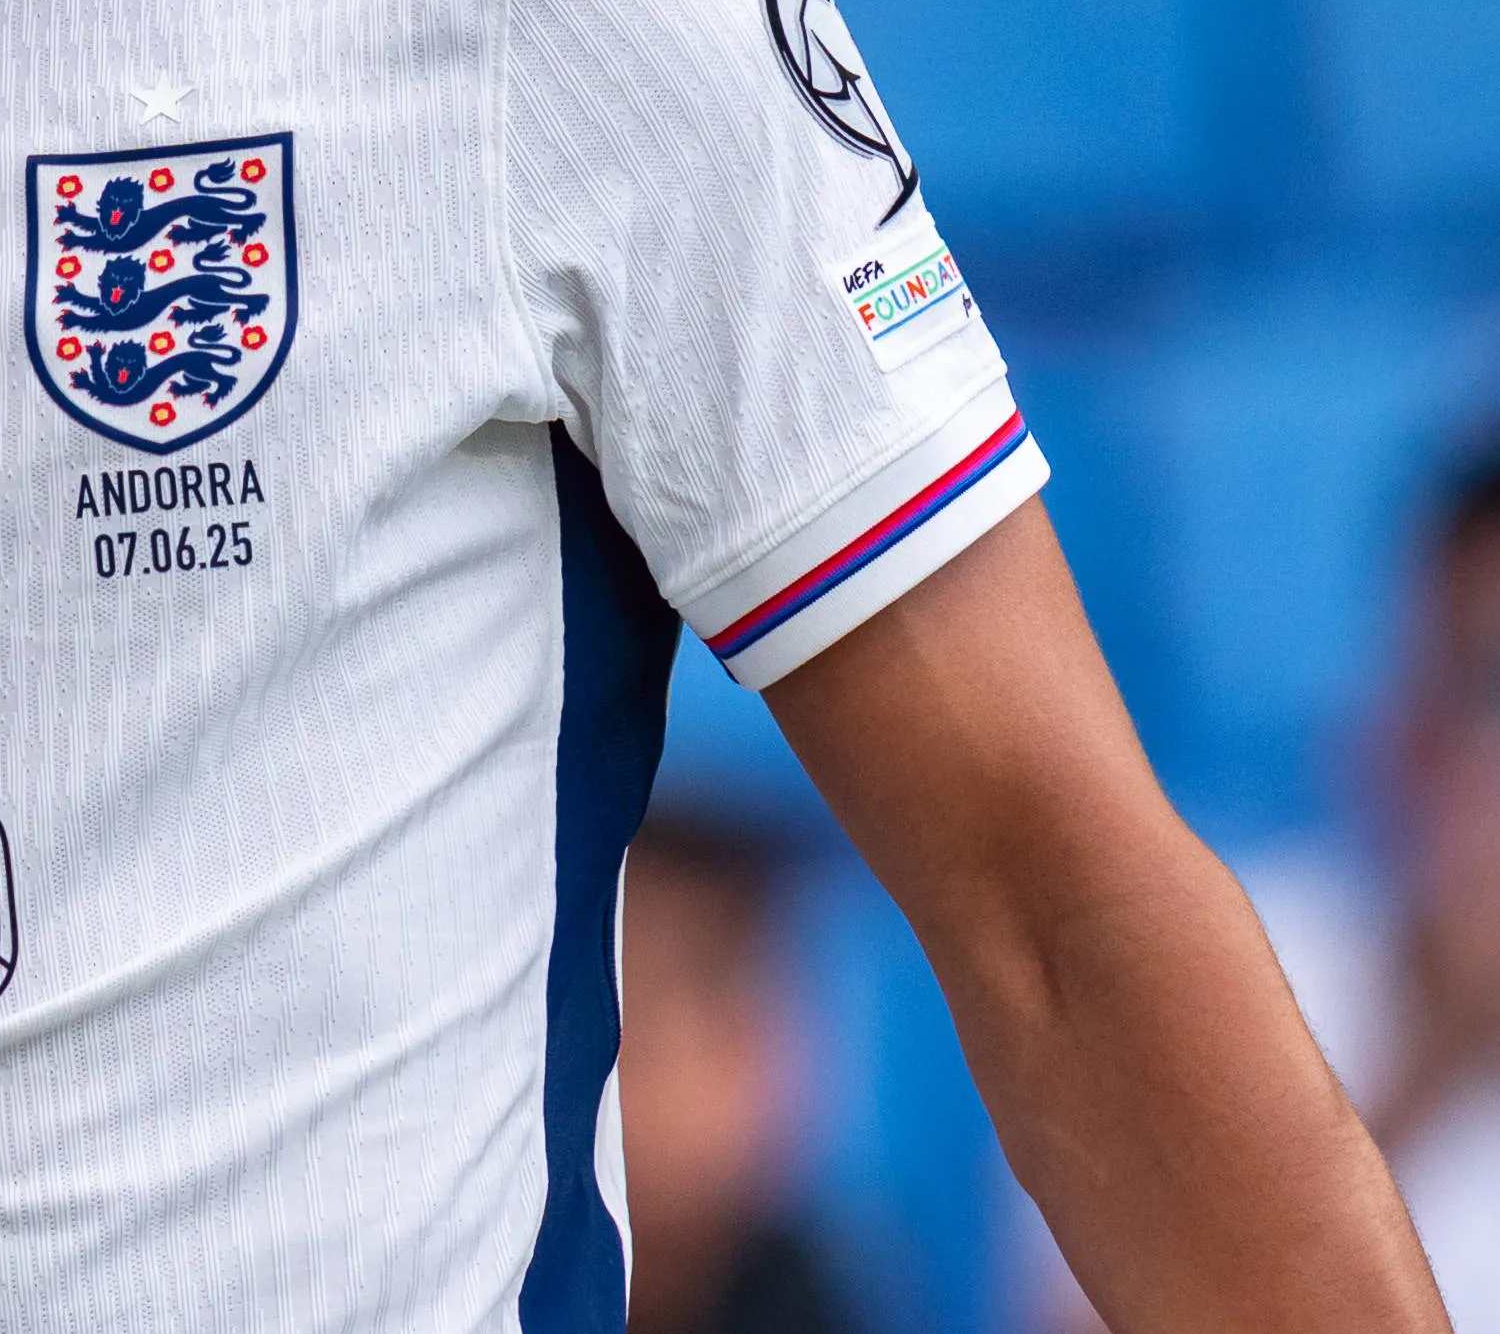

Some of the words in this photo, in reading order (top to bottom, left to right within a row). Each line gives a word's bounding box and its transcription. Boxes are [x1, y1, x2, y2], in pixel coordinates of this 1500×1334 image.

[843, 259, 885, 294] UEFA
[76, 459, 265, 519] ANDORRA
[94, 521, 253, 578] 07.06.25
